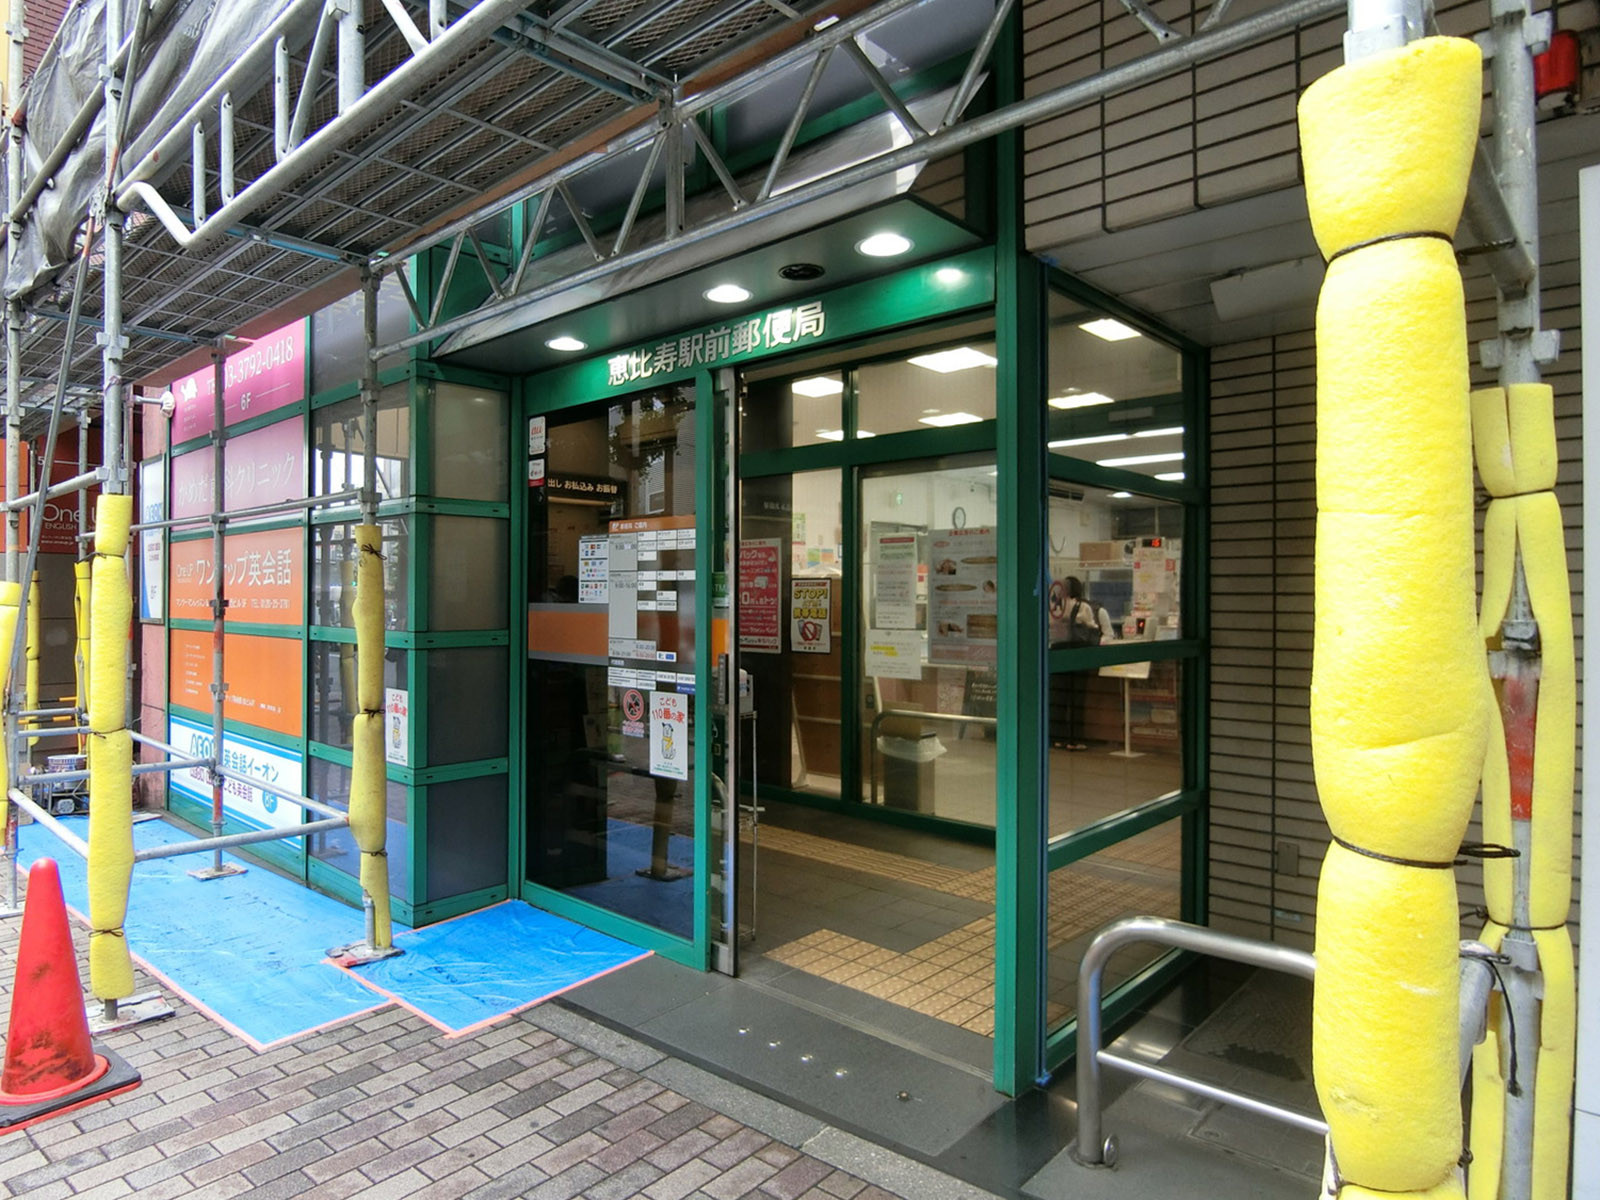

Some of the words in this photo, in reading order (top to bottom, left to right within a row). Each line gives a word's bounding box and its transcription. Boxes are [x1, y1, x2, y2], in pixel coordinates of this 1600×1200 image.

[607, 301, 826, 386] 恵比寿駅前郵便局
[241, 392, 251, 410] 6F
[179, 452, 294, 508] かめだ科クリニック
[196, 548, 292, 586] ワンップ英会話
[794, 588, 828, 599] STOP!
[659, 697, 677, 707] こども
[652, 707, 686, 724] 110番の家
